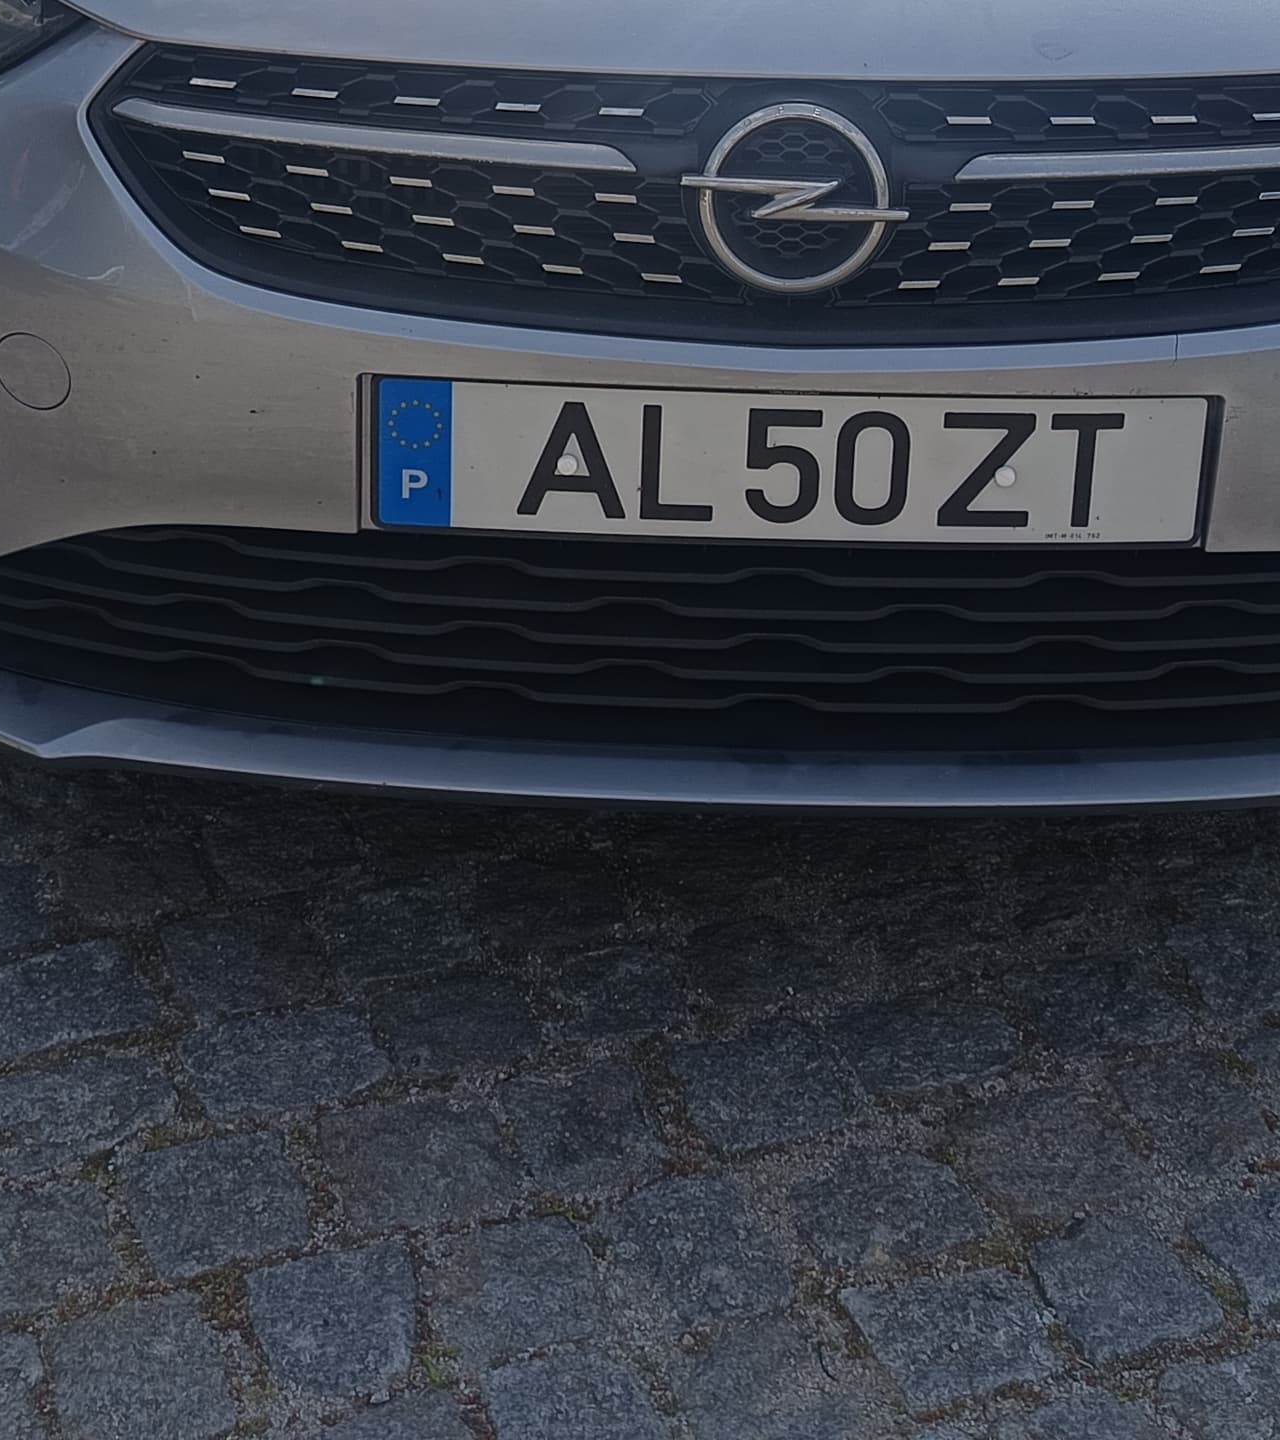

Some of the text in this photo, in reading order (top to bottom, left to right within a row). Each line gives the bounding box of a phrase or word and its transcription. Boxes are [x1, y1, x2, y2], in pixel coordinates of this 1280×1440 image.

[402, 469, 428, 499] P
[516, 401, 1126, 528] AL 50 ZT
